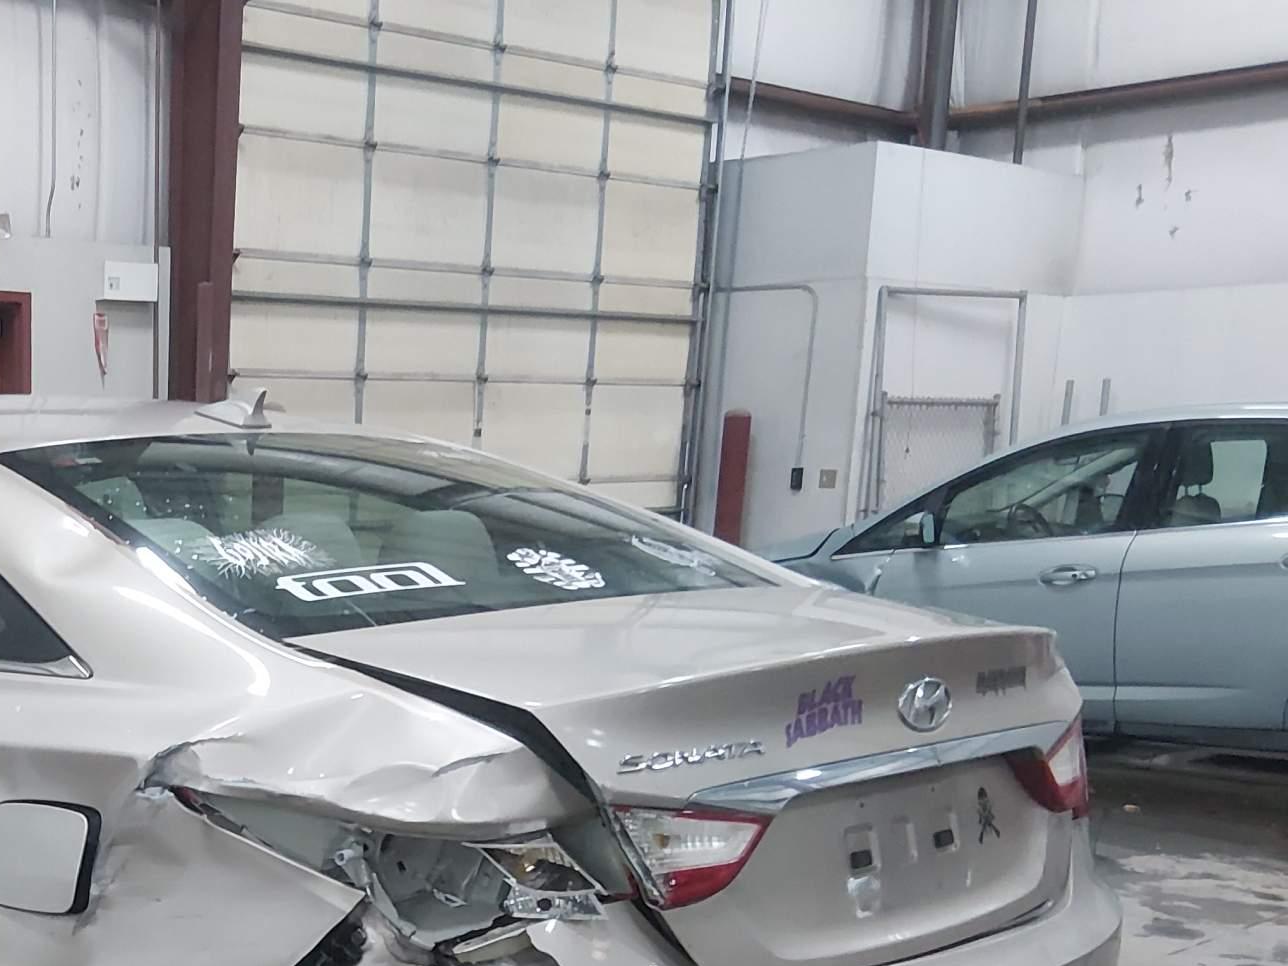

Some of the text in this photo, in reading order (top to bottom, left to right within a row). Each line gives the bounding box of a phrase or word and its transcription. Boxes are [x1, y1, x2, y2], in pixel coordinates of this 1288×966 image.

[796, 675, 856, 716] BLACK
[785, 699, 863, 748] SABBATH
[616, 740, 766, 775] SONATA
